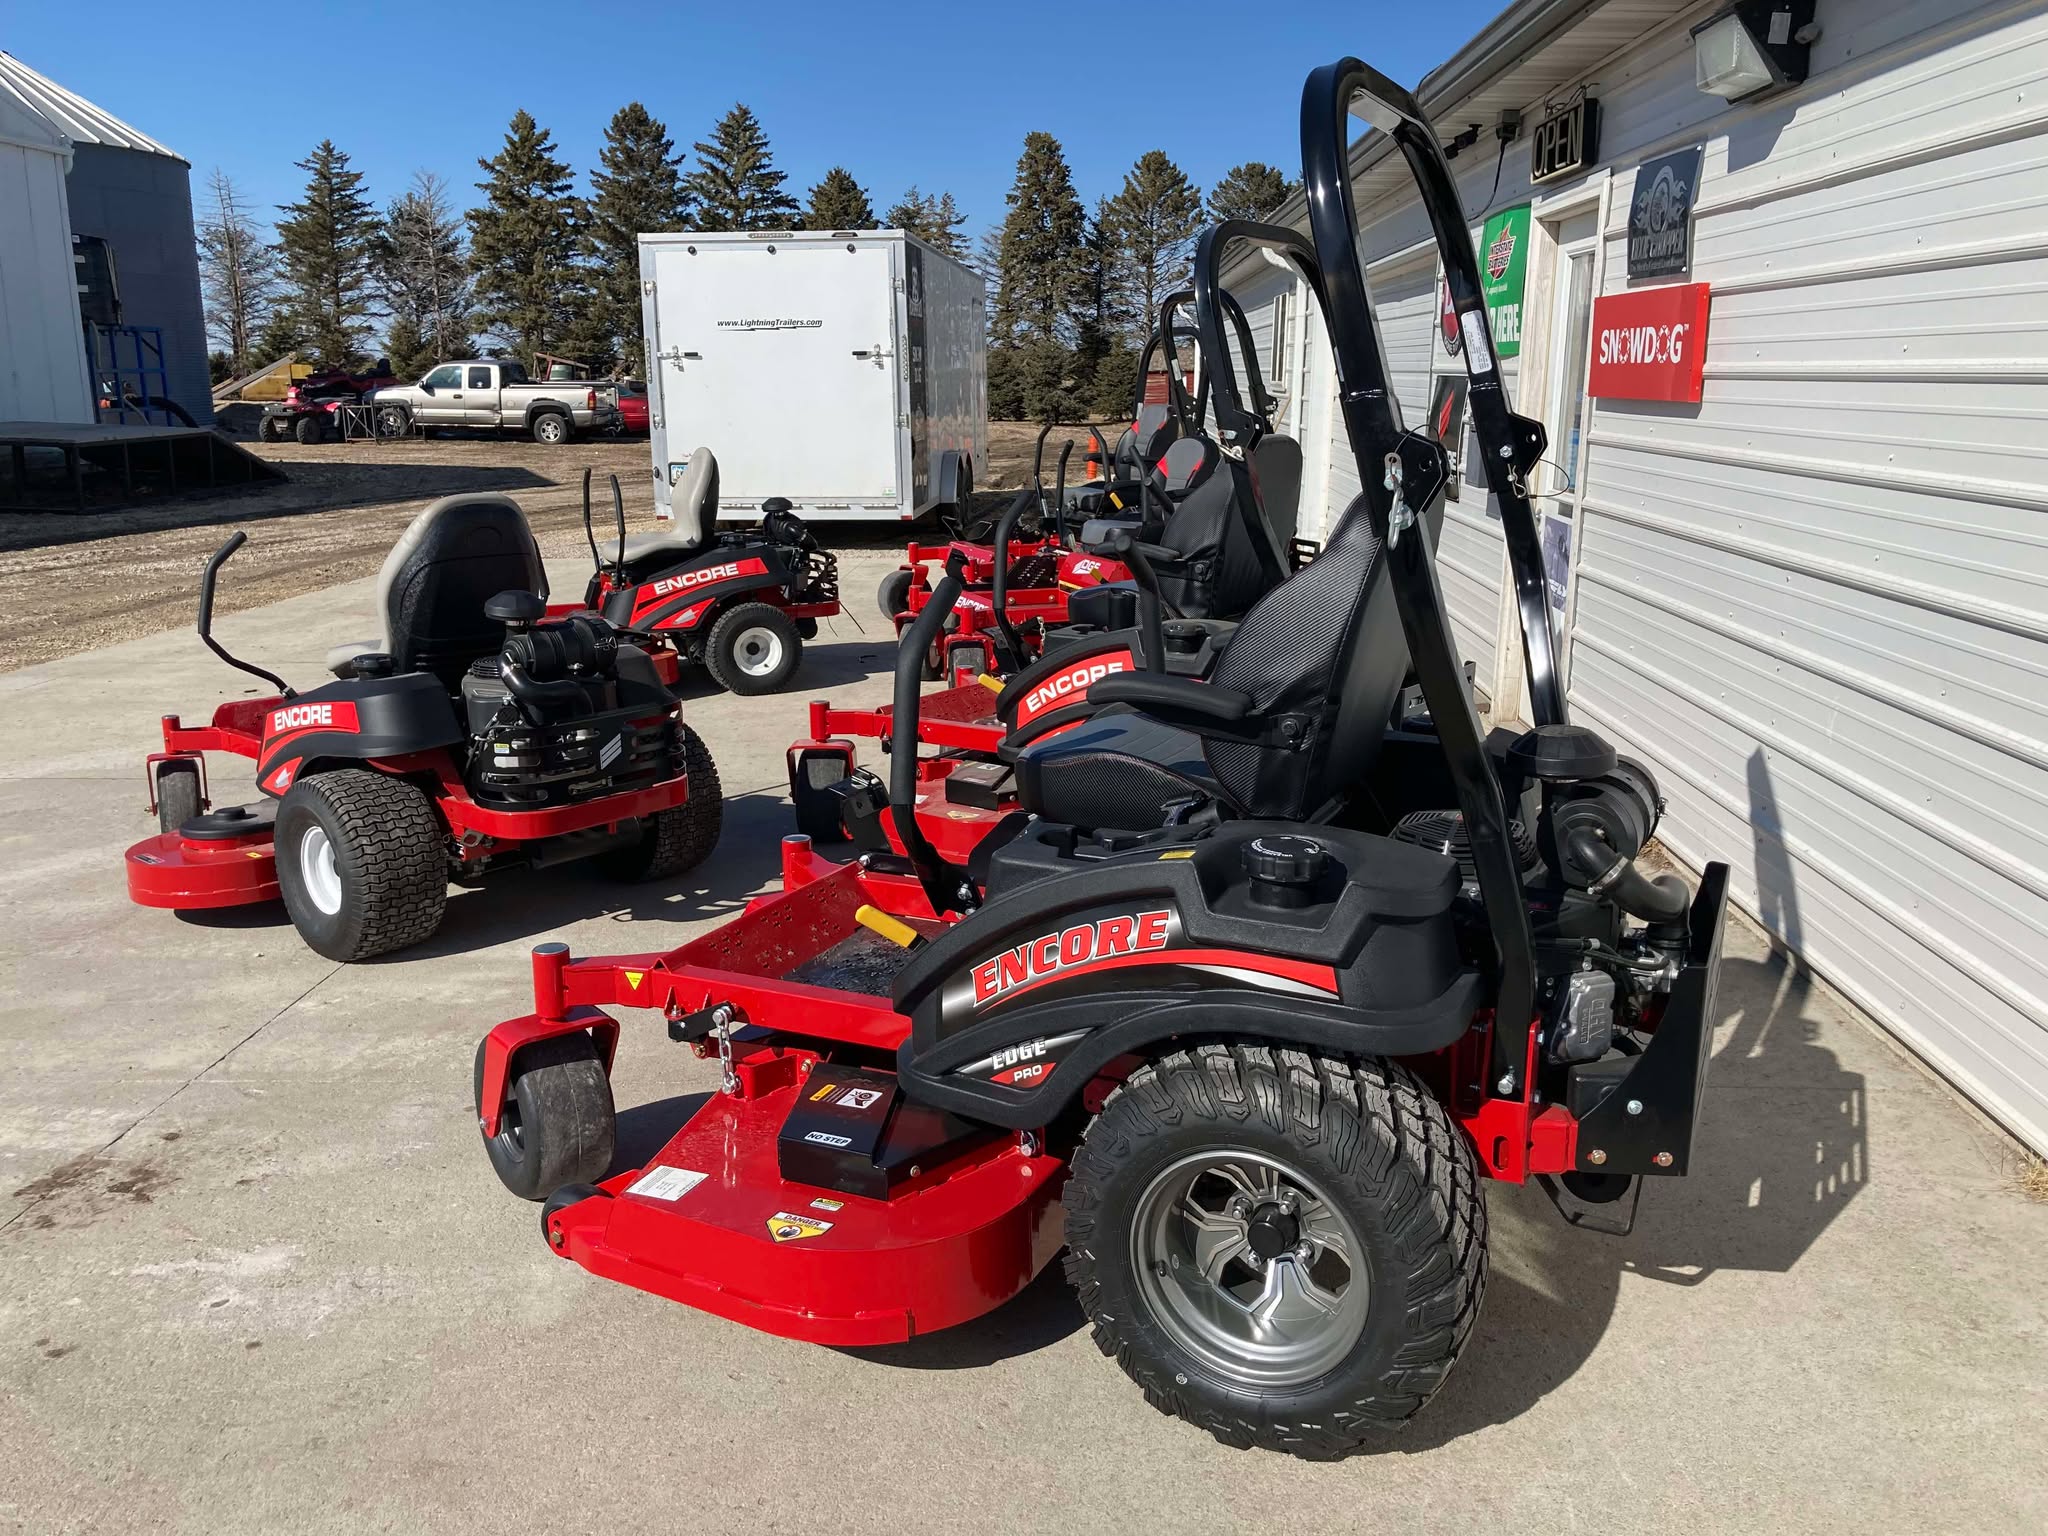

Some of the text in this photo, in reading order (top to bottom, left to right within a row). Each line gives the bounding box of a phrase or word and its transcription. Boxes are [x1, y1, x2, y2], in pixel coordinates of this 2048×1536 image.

[1533, 107, 1582, 176] OPEN
[717, 318, 823, 328] www.LightningTrailers.com
[1496, 304, 1519, 342] HERE
[1600, 324, 1684, 364] SNOWDOG
[653, 563, 739, 595] ENCORE
[274, 704, 332, 731] ENCORE
[970, 909, 1171, 1008] ENCORE
[991, 1036, 1047, 1070] EDGE
[1014, 1064, 1043, 1082] PRO
[807, 1132, 849, 1145] NO STEP
[784, 1214, 822, 1227] DANGER
